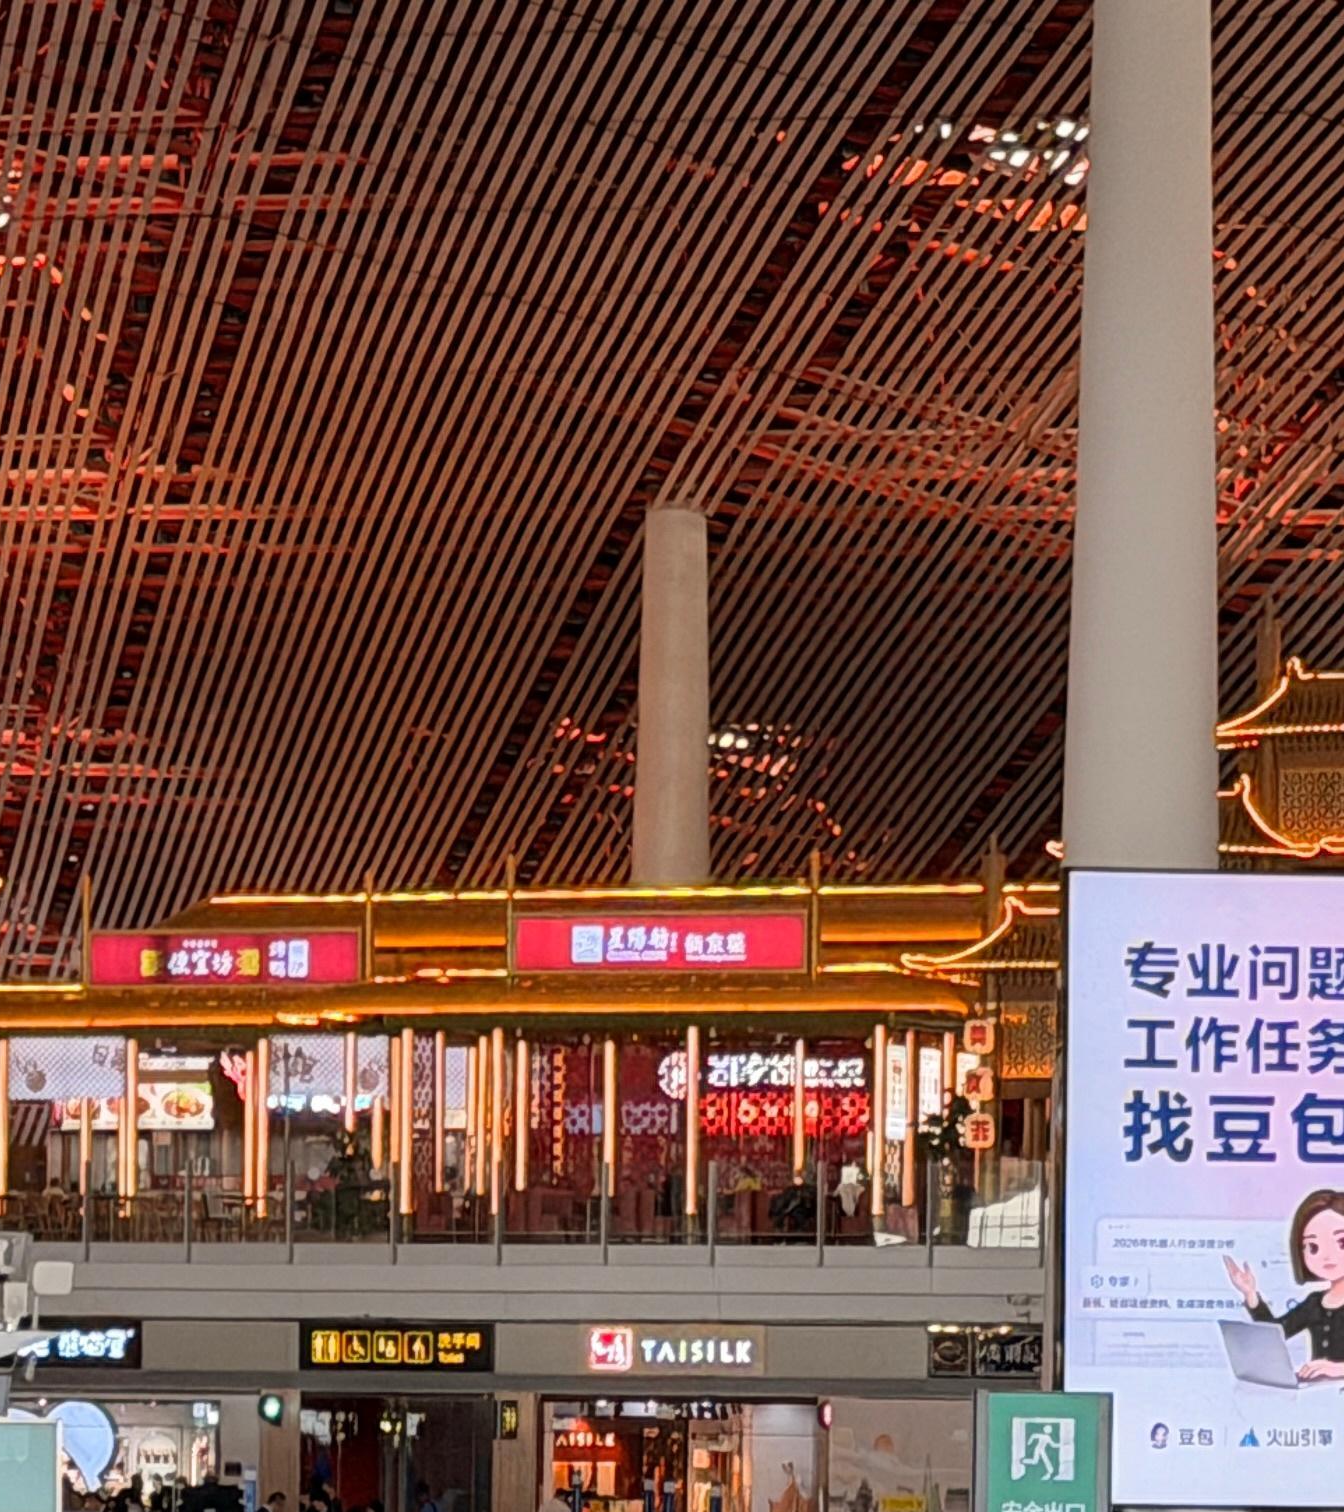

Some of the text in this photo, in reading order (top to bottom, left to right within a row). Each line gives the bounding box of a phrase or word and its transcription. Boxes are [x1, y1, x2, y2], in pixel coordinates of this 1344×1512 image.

[641, 1339, 752, 1364] TAISILK
[556, 1431, 616, 1448] AISILK
[1178, 1427, 1334, 1447] 豆包 火山引擎
